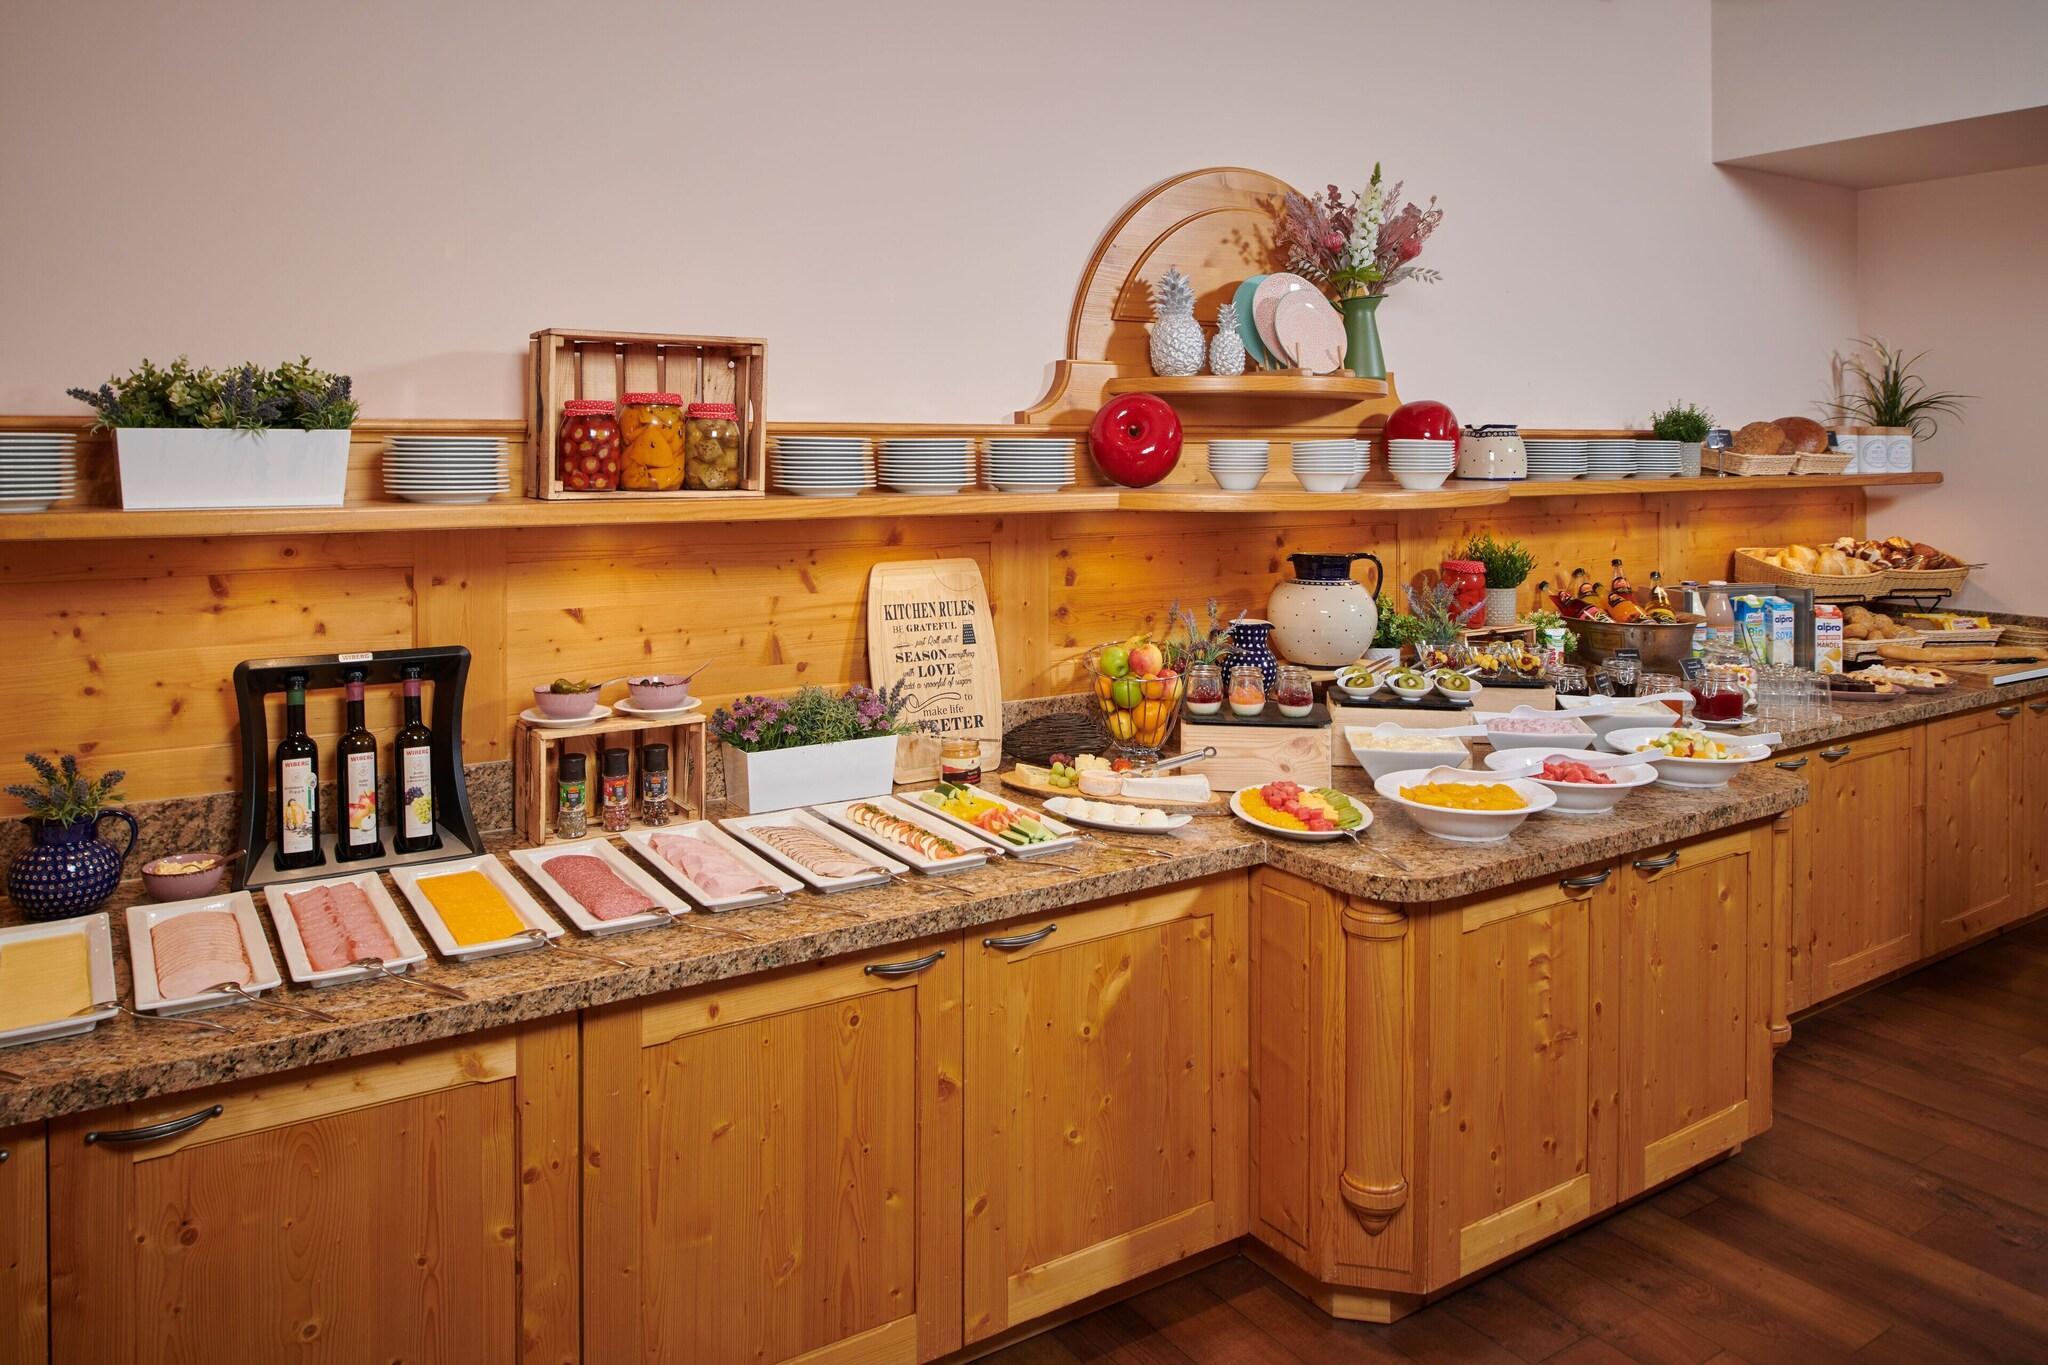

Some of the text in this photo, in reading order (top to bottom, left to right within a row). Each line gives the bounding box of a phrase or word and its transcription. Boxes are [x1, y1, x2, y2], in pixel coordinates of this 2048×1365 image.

[884, 599, 976, 621] KITCHEN RULES
[1775, 615, 1793, 625] alpro
[893, 621, 957, 634] BE GRATEFUL
[1816, 622, 1841, 633] alpro
[1775, 631, 1793, 640] SOYA
[895, 648, 975, 663] SEASON everything
[917, 663, 955, 678] LOVE
[923, 704, 964, 717] make life
[406, 748, 430, 756] WIBERG
[350, 754, 373, 762] WIBERG
[284, 760, 309, 768] WIBERG
